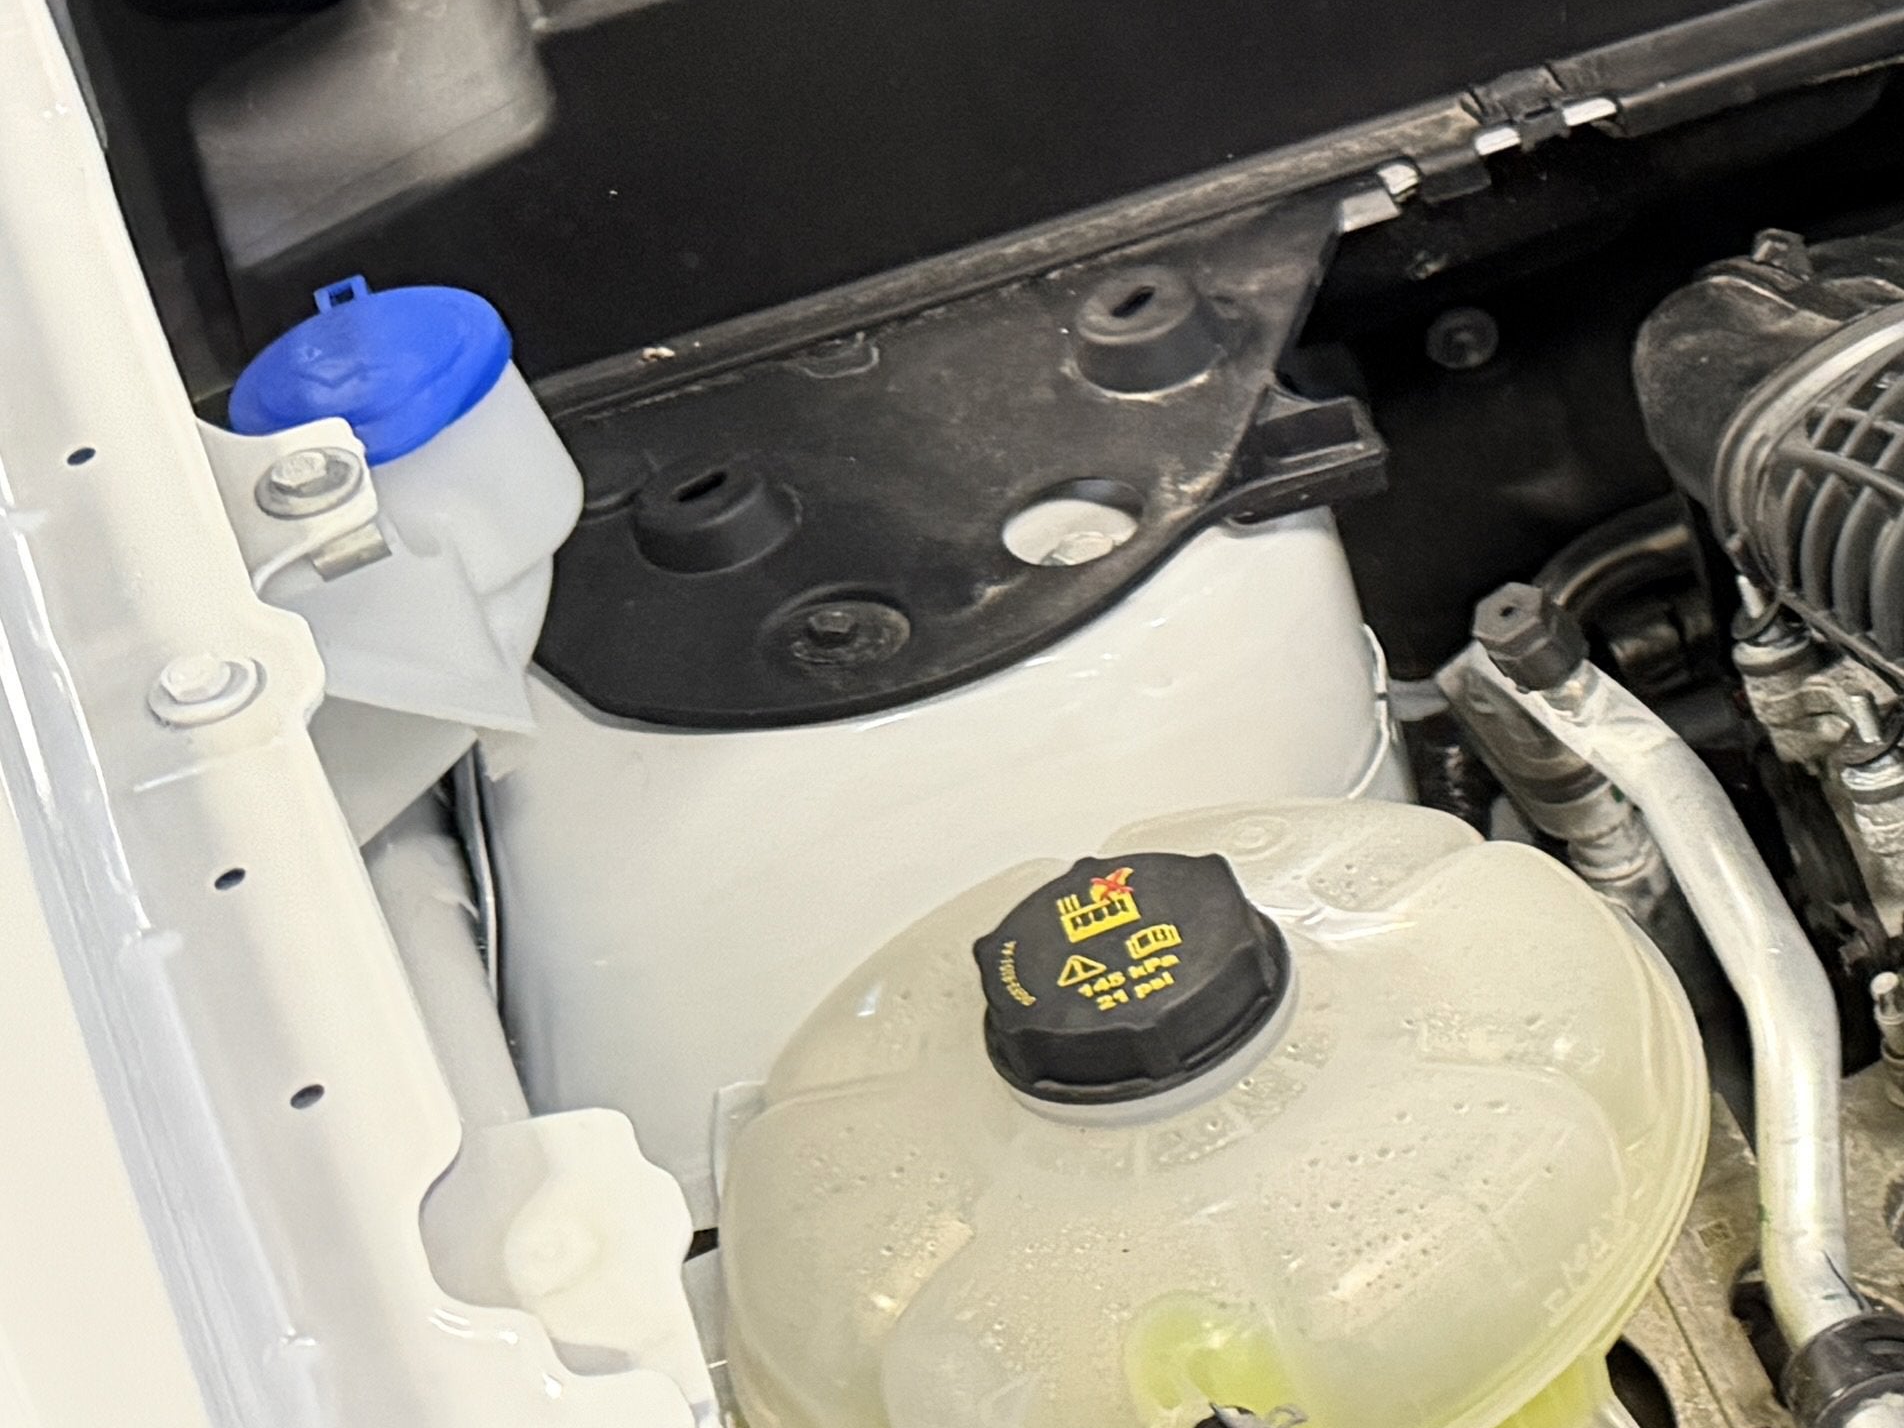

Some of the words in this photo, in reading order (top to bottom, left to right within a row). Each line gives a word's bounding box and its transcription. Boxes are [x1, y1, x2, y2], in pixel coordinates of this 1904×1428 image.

[1077, 971, 1126, 998] 145
[1128, 954, 1180, 979] kPa
[1096, 988, 1129, 1011] 21
[1134, 971, 1175, 999] psi
